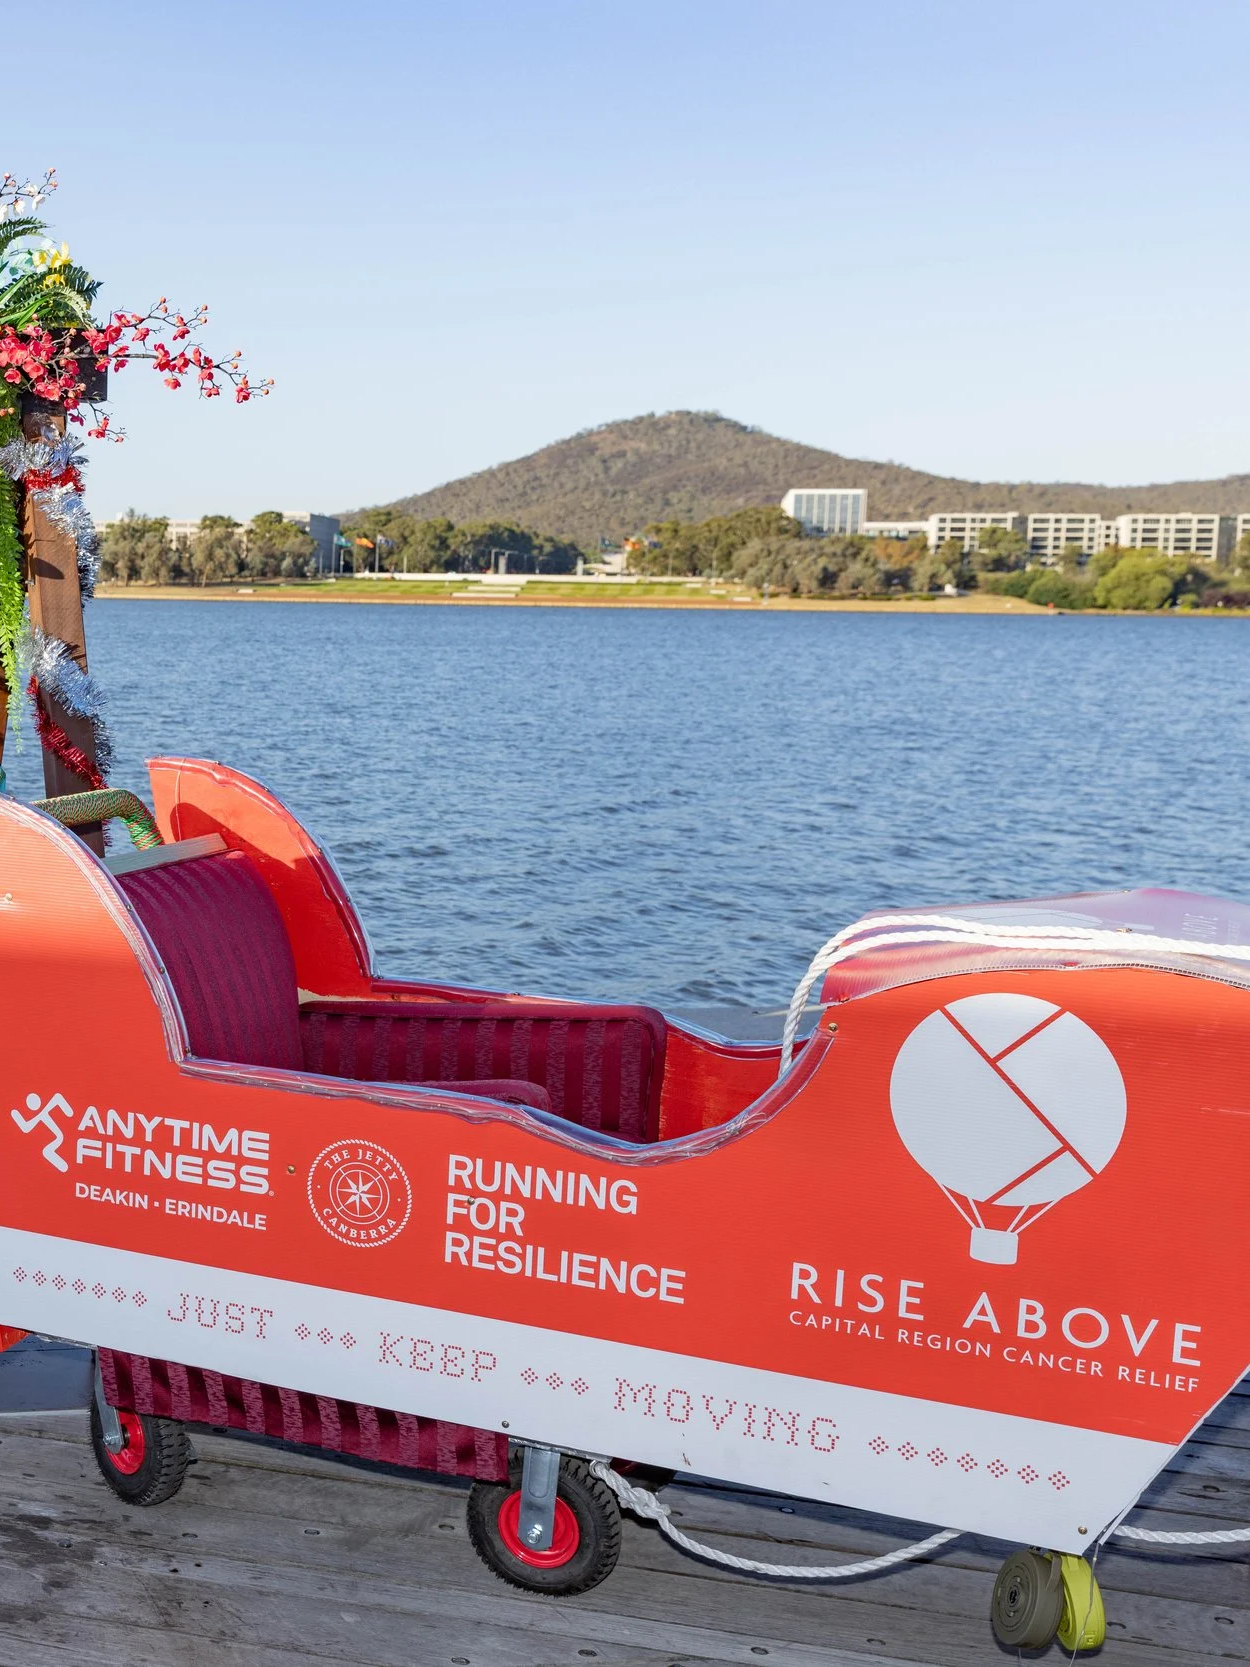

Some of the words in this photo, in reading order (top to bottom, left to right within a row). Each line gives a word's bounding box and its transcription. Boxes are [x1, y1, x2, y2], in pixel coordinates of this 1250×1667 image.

[78, 1106, 270, 1160] ANYTIME
[76, 1138, 270, 1195] FITNESS
[323, 1149, 351, 1170] THE
[357, 1148, 399, 1181] JETTY
[447, 1153, 638, 1215] RUNNING
[75, 1182, 149, 1210] DEAKIN
[164, 1198, 267, 1231] ERINDALE
[322, 1207, 397, 1240] CANBERRA
[446, 1193, 526, 1237] FOR
[444, 1230, 687, 1305] RESILIENCE
[790, 1261, 925, 1321] RISE
[962, 1291, 1202, 1367] ABOVE
[167, 1292, 274, 1340] JUST
[378, 1331, 498, 1383] KEEP
[613, 1376, 841, 1454] MOVING
[789, 1310, 885, 1340] CAPITAL
[897, 1328, 991, 1358] REGION
[1002, 1347, 1103, 1377] CANCER
[1117, 1365, 1199, 1393] RELIEF
